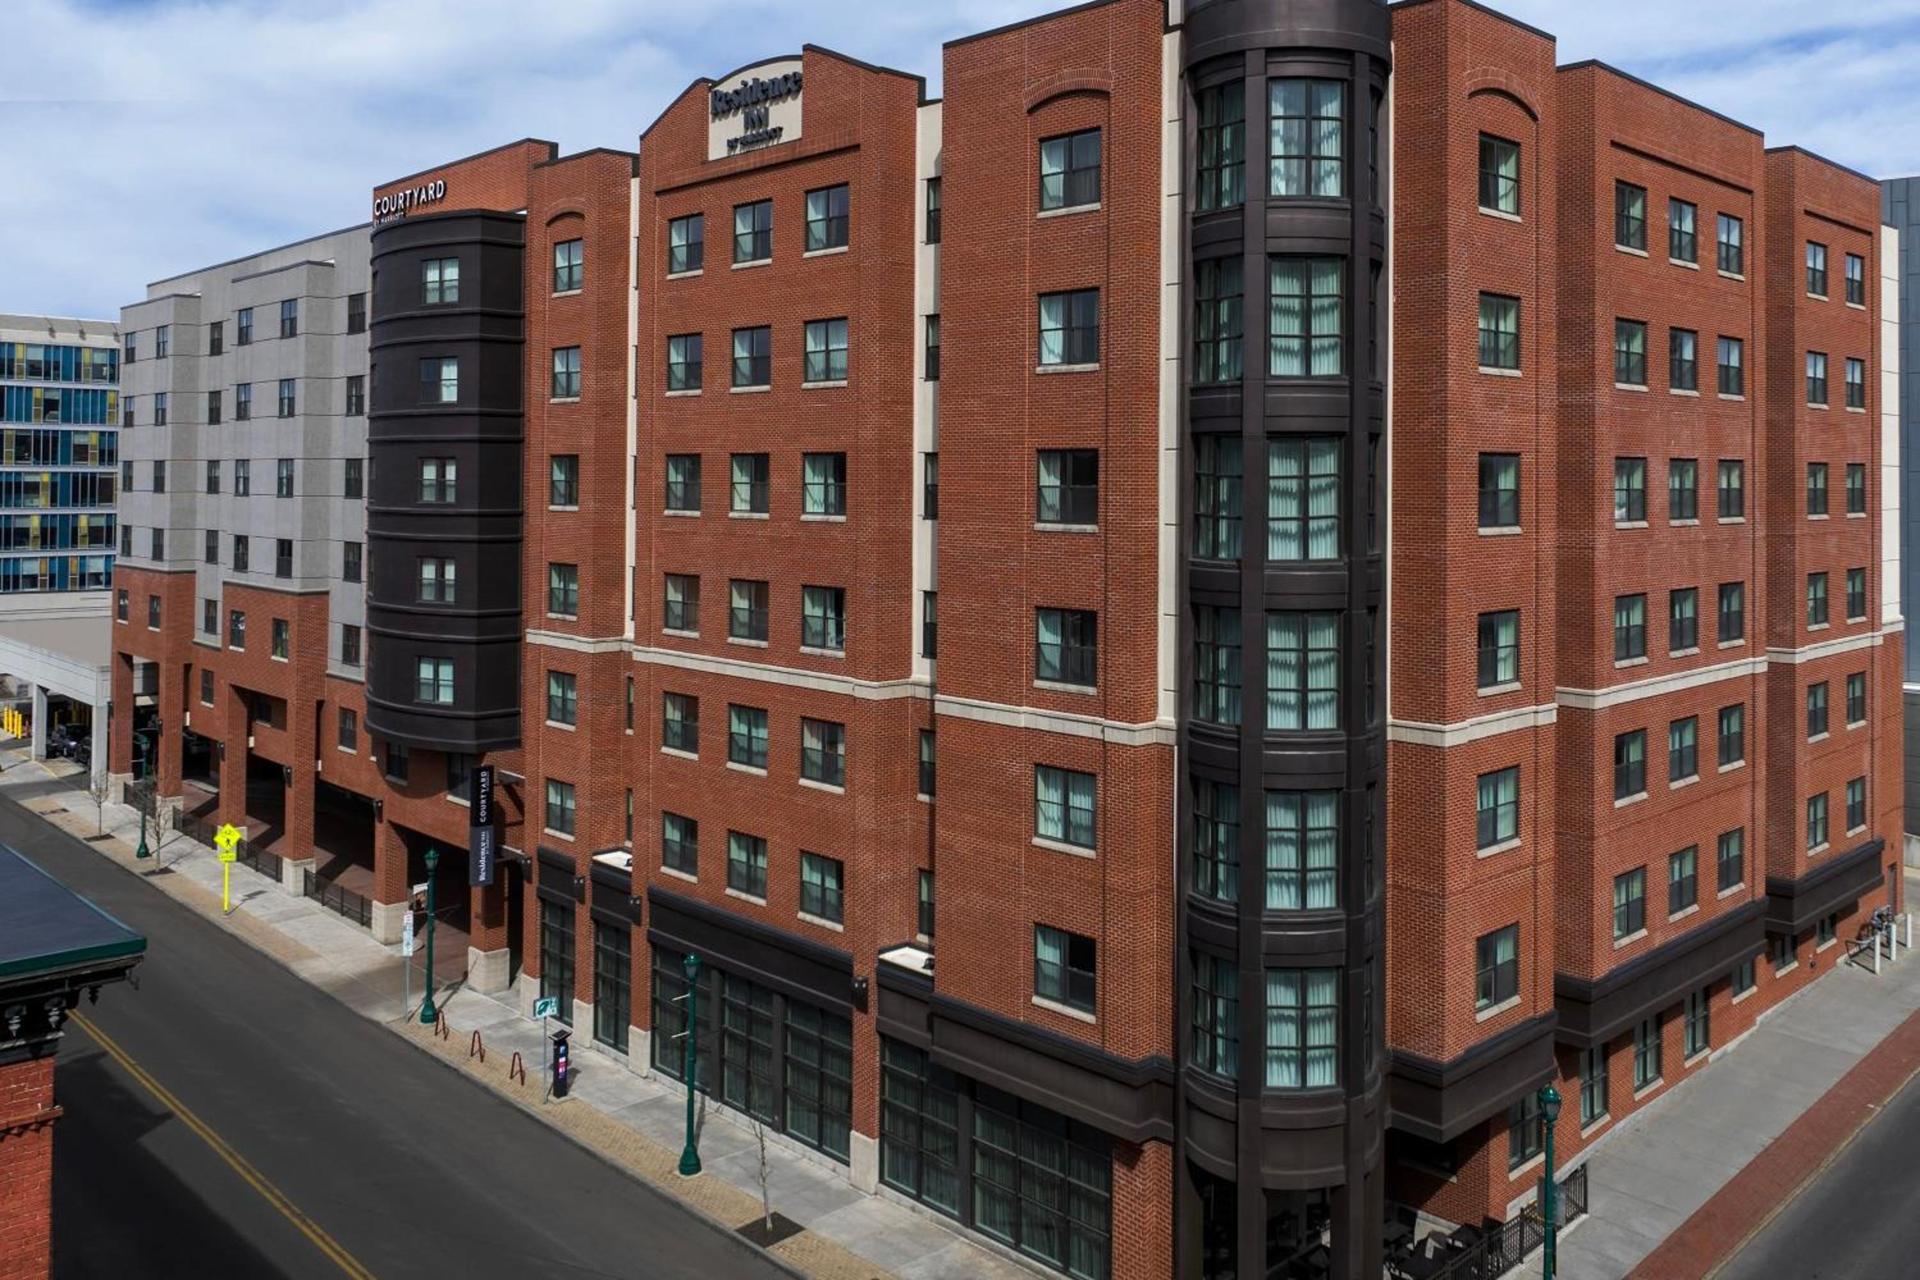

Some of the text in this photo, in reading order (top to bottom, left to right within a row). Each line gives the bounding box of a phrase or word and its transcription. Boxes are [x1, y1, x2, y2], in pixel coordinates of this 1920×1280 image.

[711, 71, 802, 116] Residence
[374, 180, 446, 216] COURTYARD
[479, 771, 487, 823] COURTYARD
